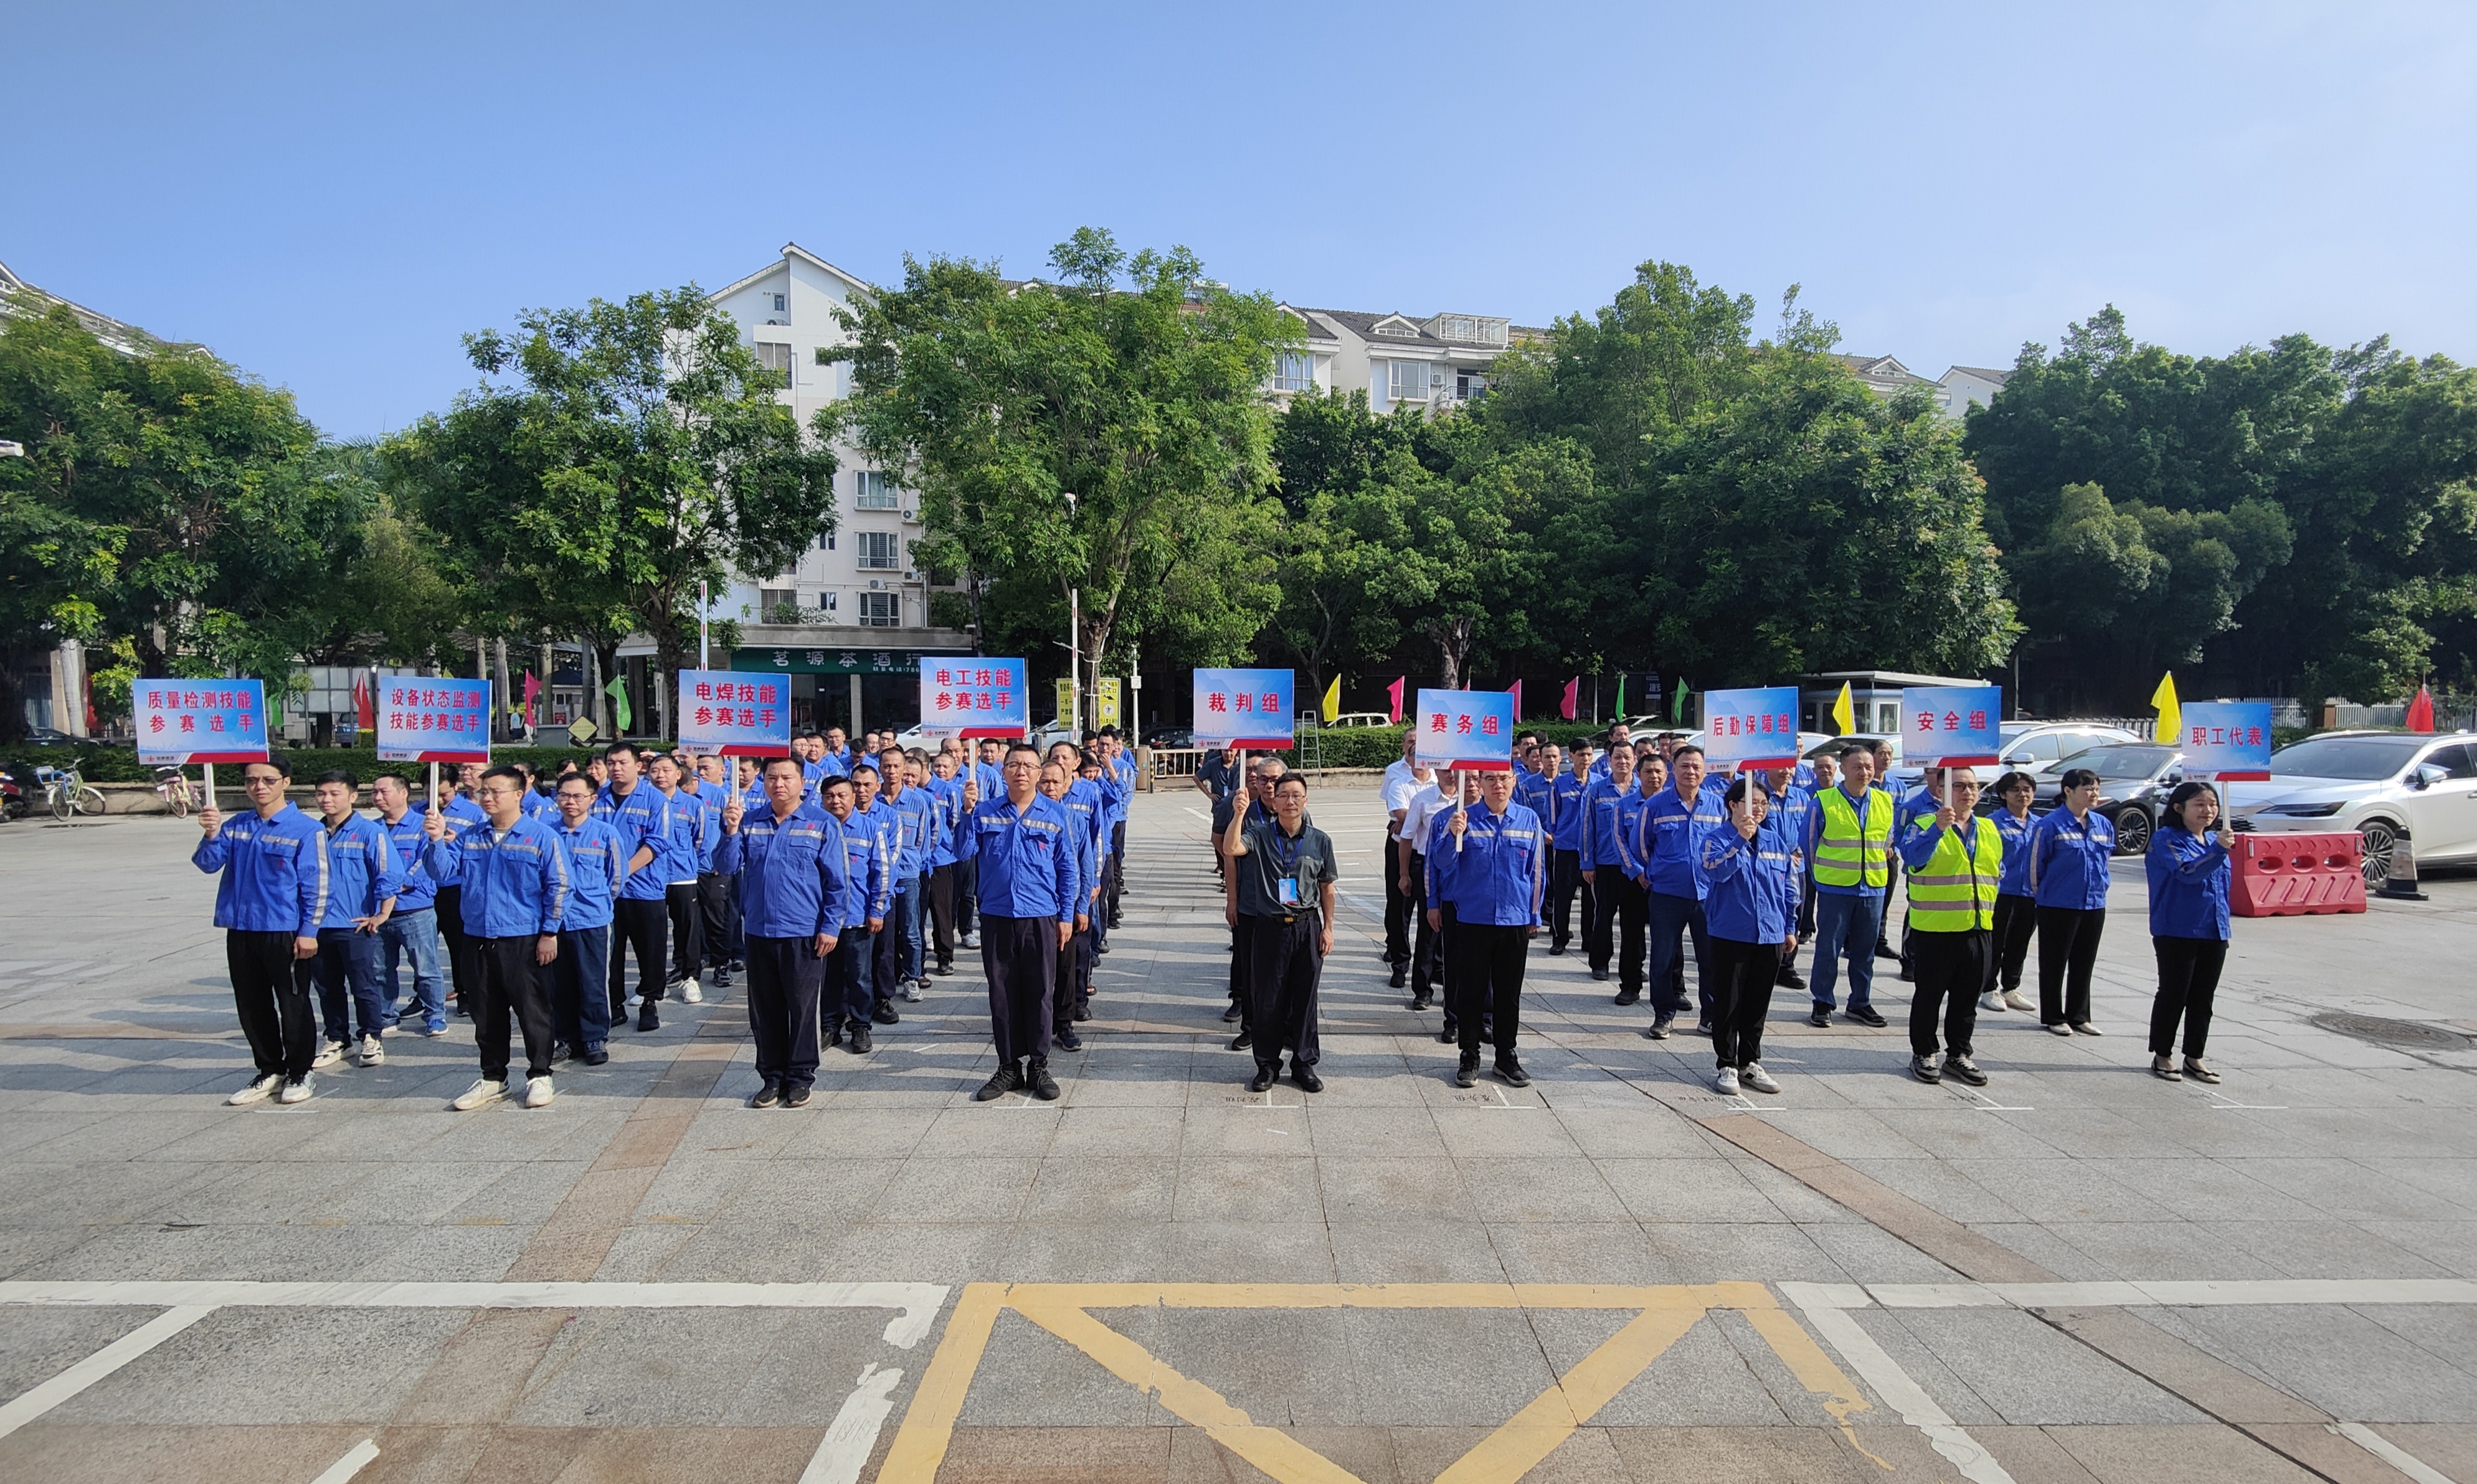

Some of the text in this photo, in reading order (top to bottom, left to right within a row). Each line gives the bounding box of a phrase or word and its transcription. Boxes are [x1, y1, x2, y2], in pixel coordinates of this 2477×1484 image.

[936, 668, 1011, 686] 电工技能
[148, 691, 252, 709] 质量检测技能
[391, 688, 481, 709] 设备状态监测
[696, 681, 777, 704] 电焊技能
[935, 692, 1012, 710] 参赛选手
[1208, 692, 1280, 712] 裁判组
[149, 714, 253, 733] 参赛选手
[390, 711, 480, 732] 技能参赛选手
[694, 706, 777, 728] 参赛选手
[1431, 713, 1499, 734] 赛务组
[1713, 714, 1789, 737] 后勤保障组
[1918, 710, 1986, 731] 安全组
[2192, 726, 2262, 746] 职工代表
